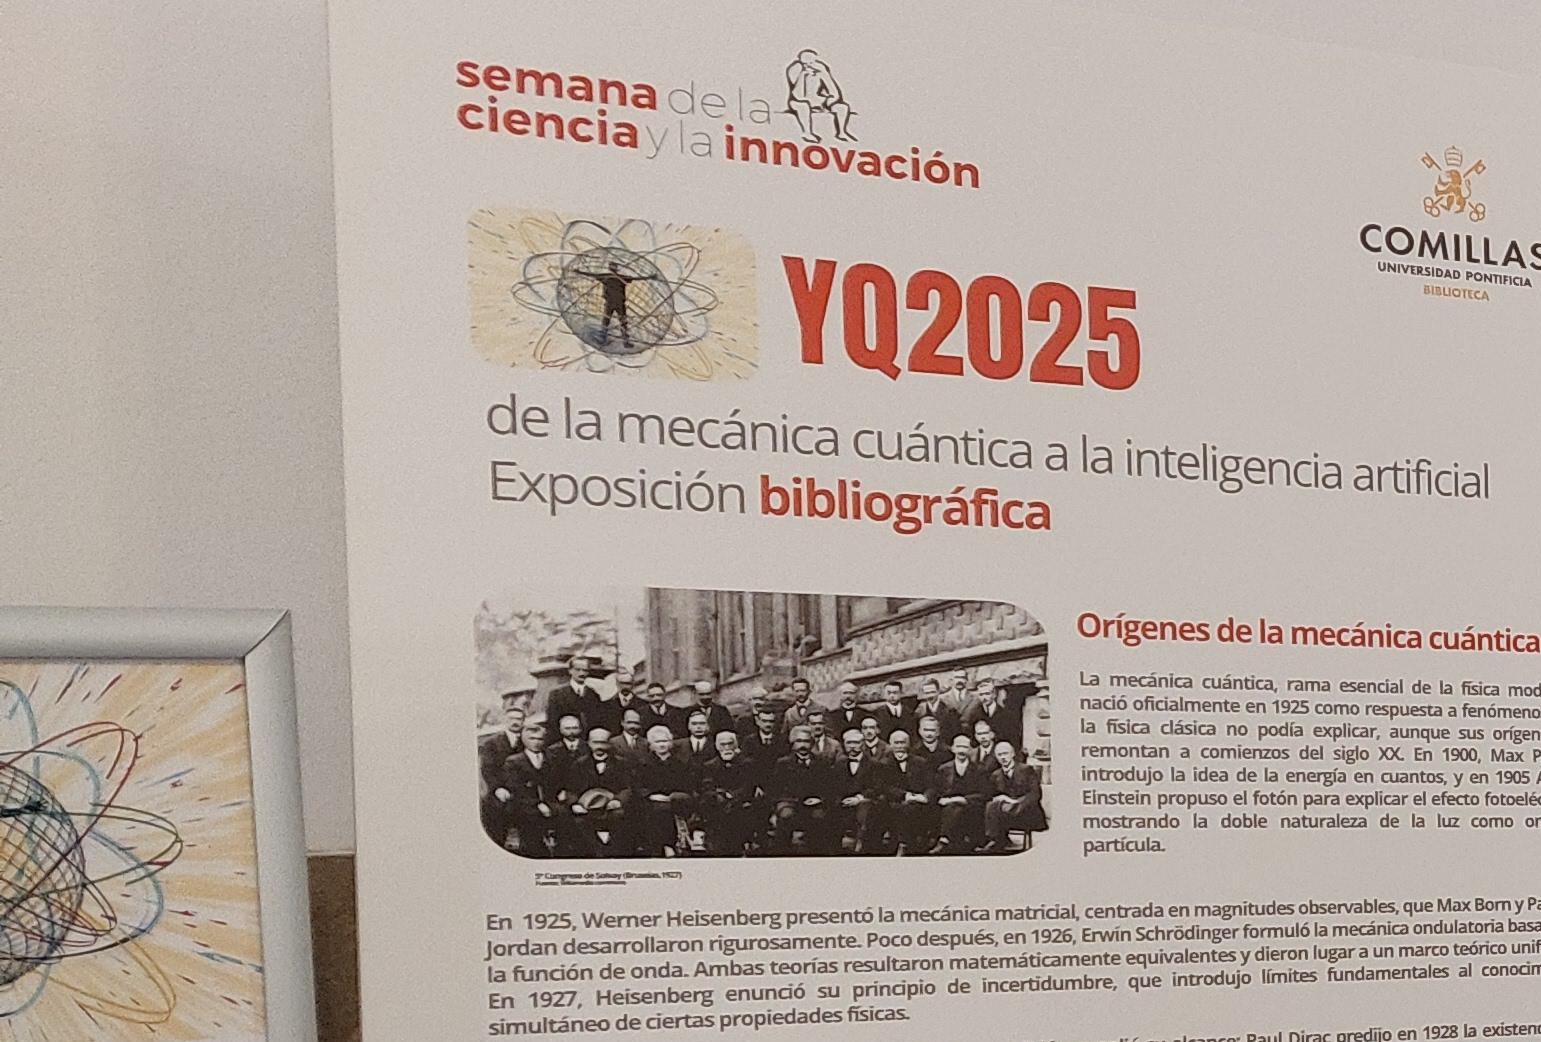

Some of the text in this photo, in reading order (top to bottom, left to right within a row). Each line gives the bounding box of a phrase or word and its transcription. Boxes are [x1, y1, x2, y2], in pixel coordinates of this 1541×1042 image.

[456, 61, 770, 124] semana de la
[457, 95, 980, 188] ciencia y la innovación
[1378, 261, 1532, 288] UNIVERSIDAD PONTIFICIA
[1423, 285, 1489, 301] BIBLIOTECA
[781, 255, 1140, 390] YQ2025
[486, 392, 1489, 500] de la mecánica cuántica a la inteligencia artificial
[490, 460, 1051, 535] Exposición bibliográfica
[1077, 612, 1541, 653] Orígenes de la mecánica cuántica
[1079, 671, 1100, 687] La
[1109, 671, 1193, 689] mecánica
[1201, 673, 1278, 694] cuántica,
[1287, 679, 1331, 692] rama
[1339, 678, 1404, 694] esencial
[1411, 679, 1432, 695] de
[1439, 679, 1453, 695] la
[1461, 680, 1500, 697] física
[1083, 836, 1166, 858] partícula.
[486, 913, 513, 931] En
[522, 912, 577, 932] 1925,
[581, 912, 663, 929] Werner
[666, 908, 782, 930] Heisenberg
[785, 906, 874, 930] presentó
[878, 906, 895, 923] la
[899, 904, 990, 923] mecánica
[994, 903, 1080, 922] matricial,
[1084, 901, 1164, 920] centrada
[1167, 905, 1190, 918] en
[1194, 899, 1295, 921] magnitudes
[1298, 898, 1400, 916] observables,
[1402, 901, 1434, 918] que
[1436, 897, 1472, 913] Max
[1474, 897, 1512, 912] Born
[1514, 899, 1525, 916] y
[488, 1005, 911, 1036] simultáneo de ciertas propiedades físicas.
